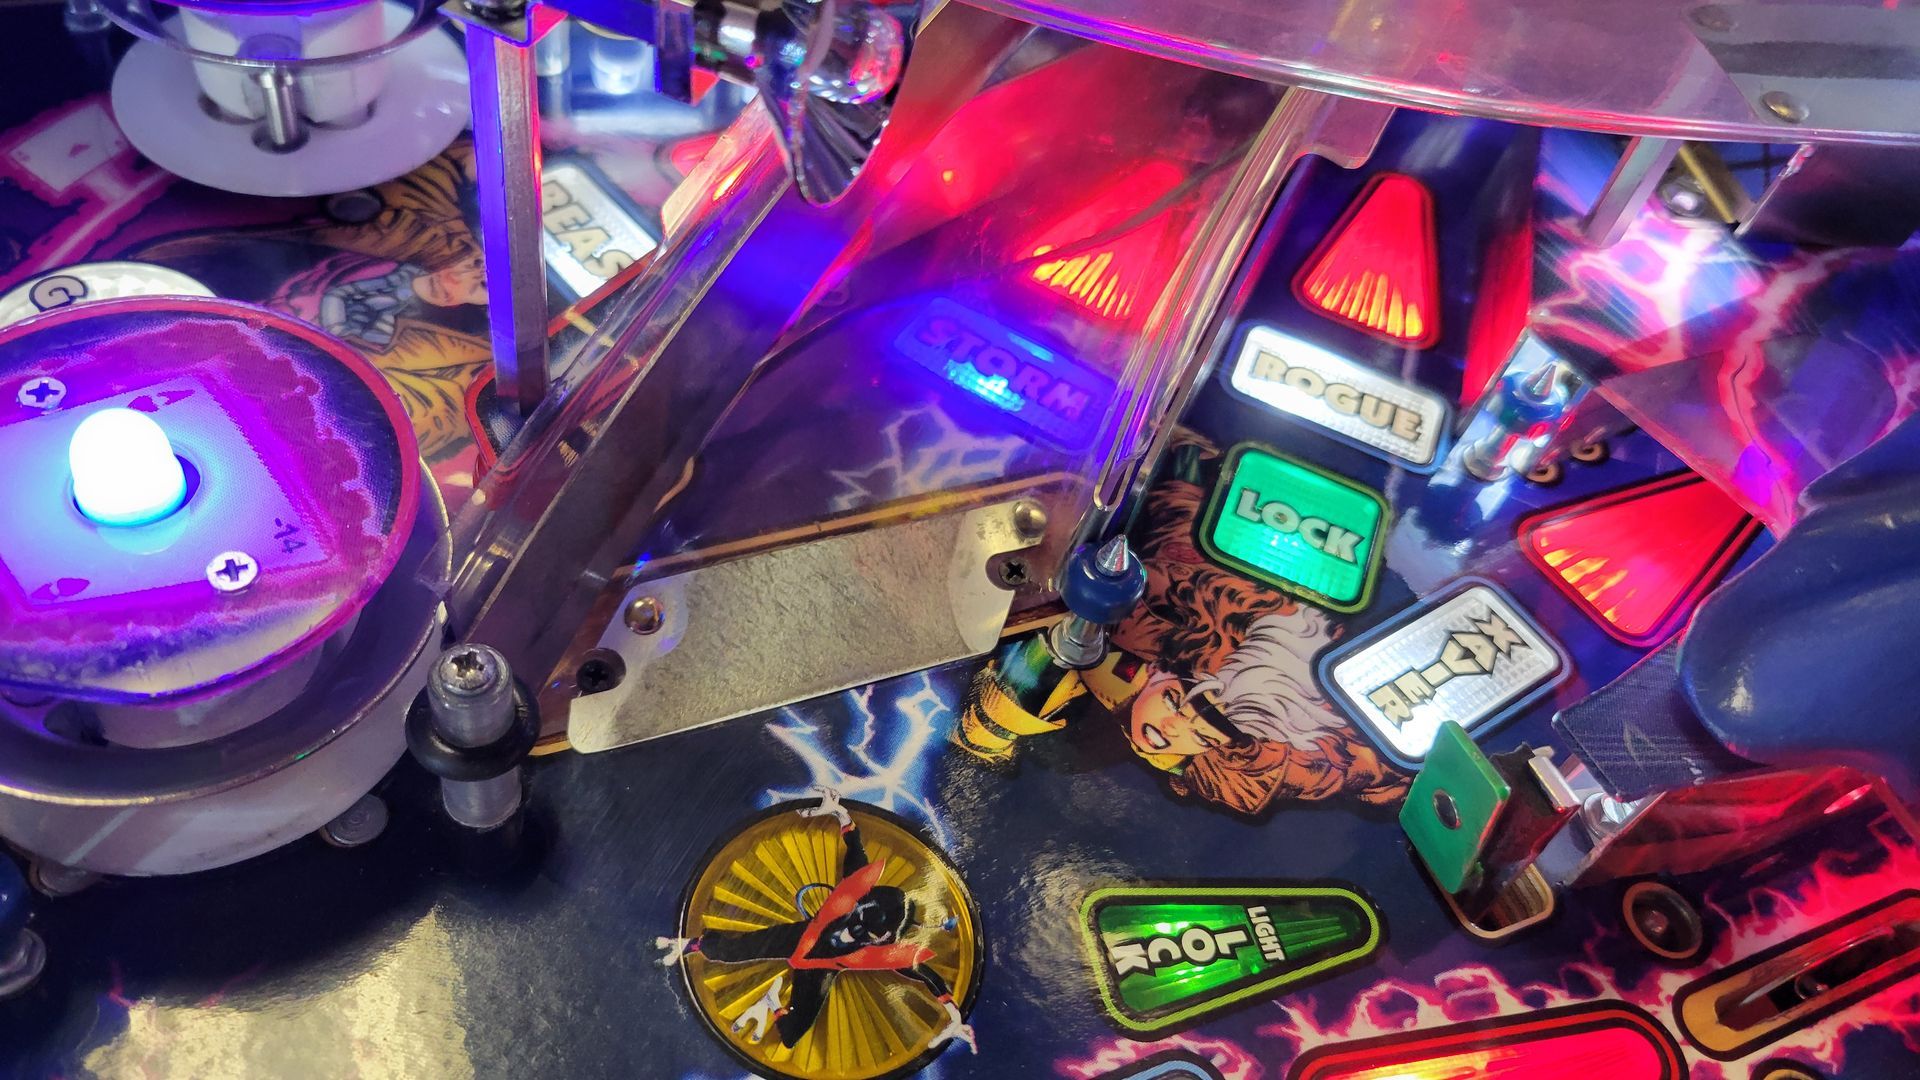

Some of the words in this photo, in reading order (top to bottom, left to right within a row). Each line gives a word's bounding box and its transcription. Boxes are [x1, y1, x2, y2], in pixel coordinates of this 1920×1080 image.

[914, 318, 1091, 422] STORM
[1252, 350, 1423, 442] ROGUE
[1235, 487, 1366, 565] LOCK
[1366, 606, 1532, 731] XAVIER
[1111, 927, 1248, 976] LOCK
[1247, 905, 1286, 961] LIGHT
